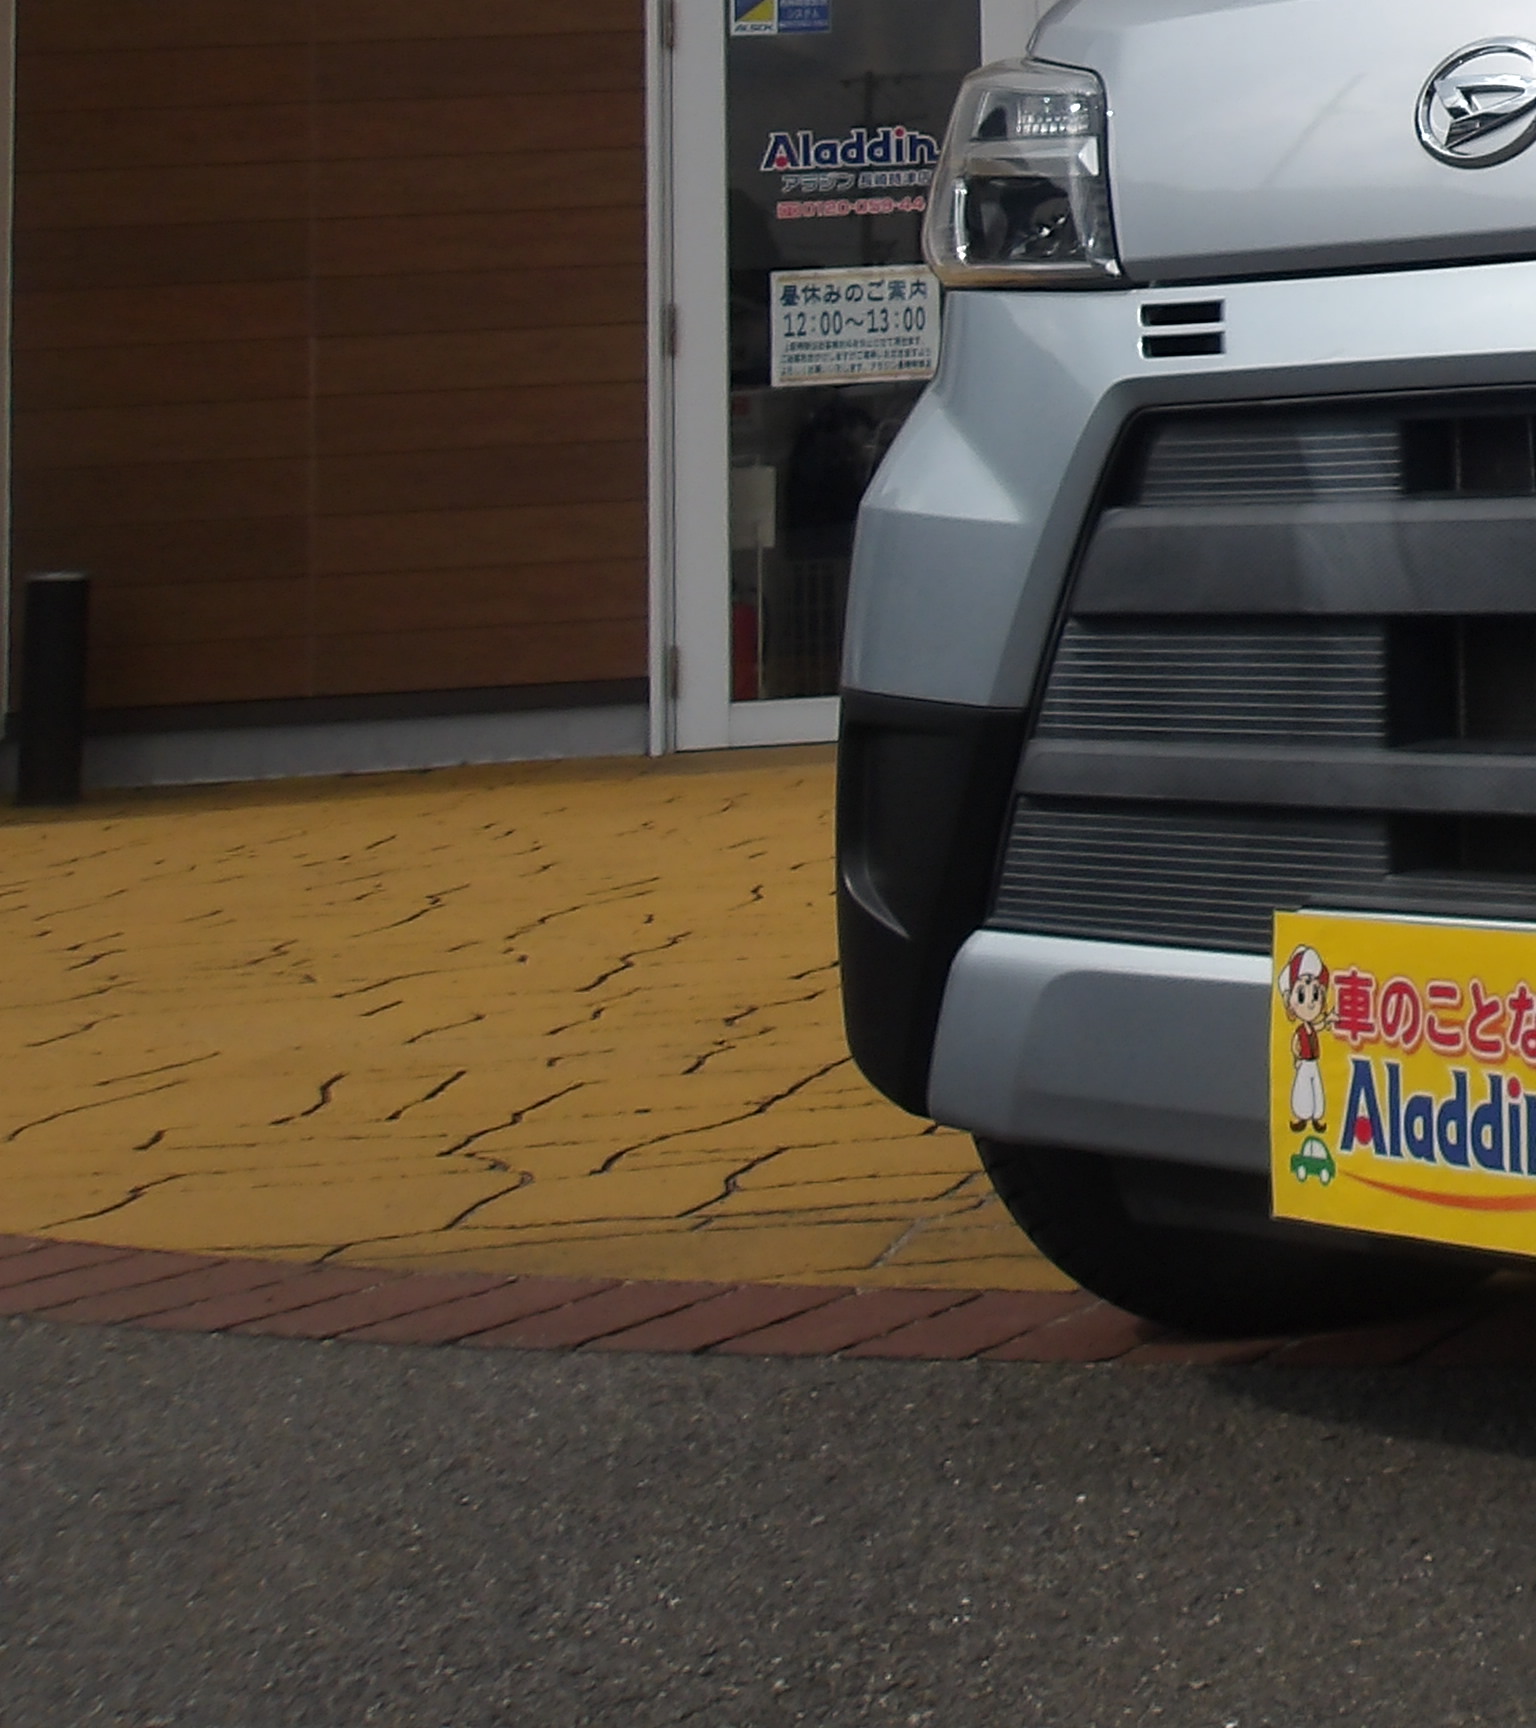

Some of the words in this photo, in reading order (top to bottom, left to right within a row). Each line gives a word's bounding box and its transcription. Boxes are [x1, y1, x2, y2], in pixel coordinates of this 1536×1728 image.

[734, 24, 774, 32] ALSOK
[761, 126, 942, 170] Aladdin
[781, 172, 855, 193] アラジン
[780, 280, 928, 307] 昼休みのご案内
